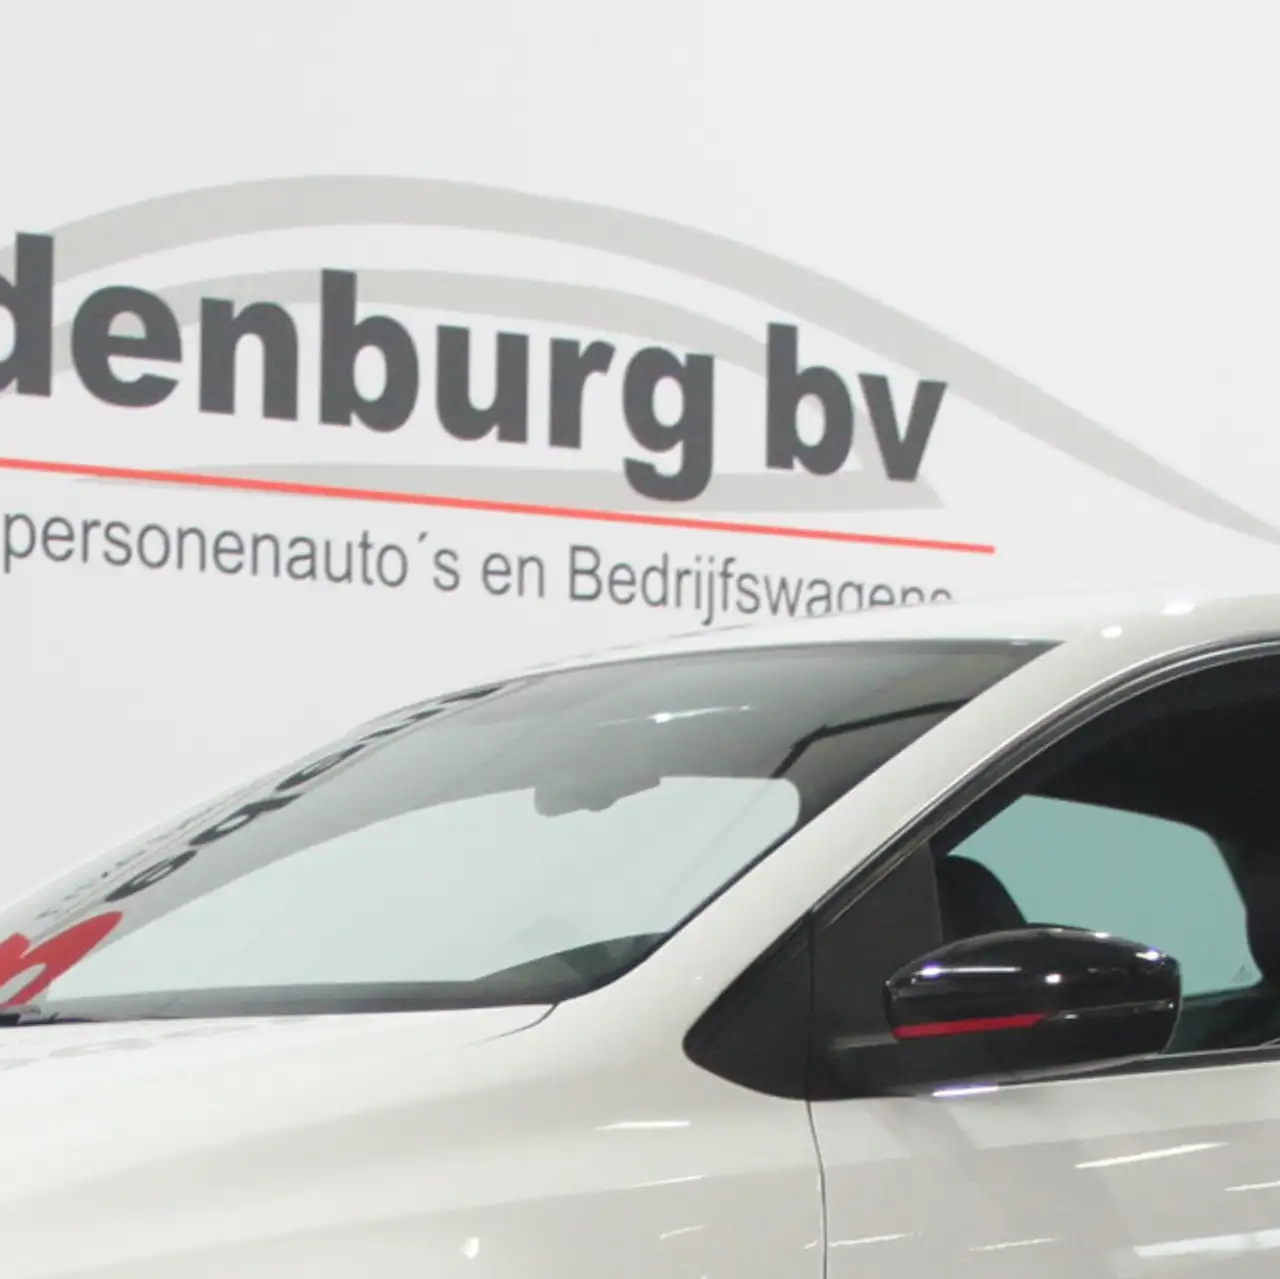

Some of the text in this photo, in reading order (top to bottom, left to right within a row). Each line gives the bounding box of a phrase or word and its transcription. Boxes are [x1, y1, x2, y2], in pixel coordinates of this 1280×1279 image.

[767, 323, 946, 482] bv
[481, 551, 546, 598] en
[568, 543, 951, 627] Bedrijfswage
